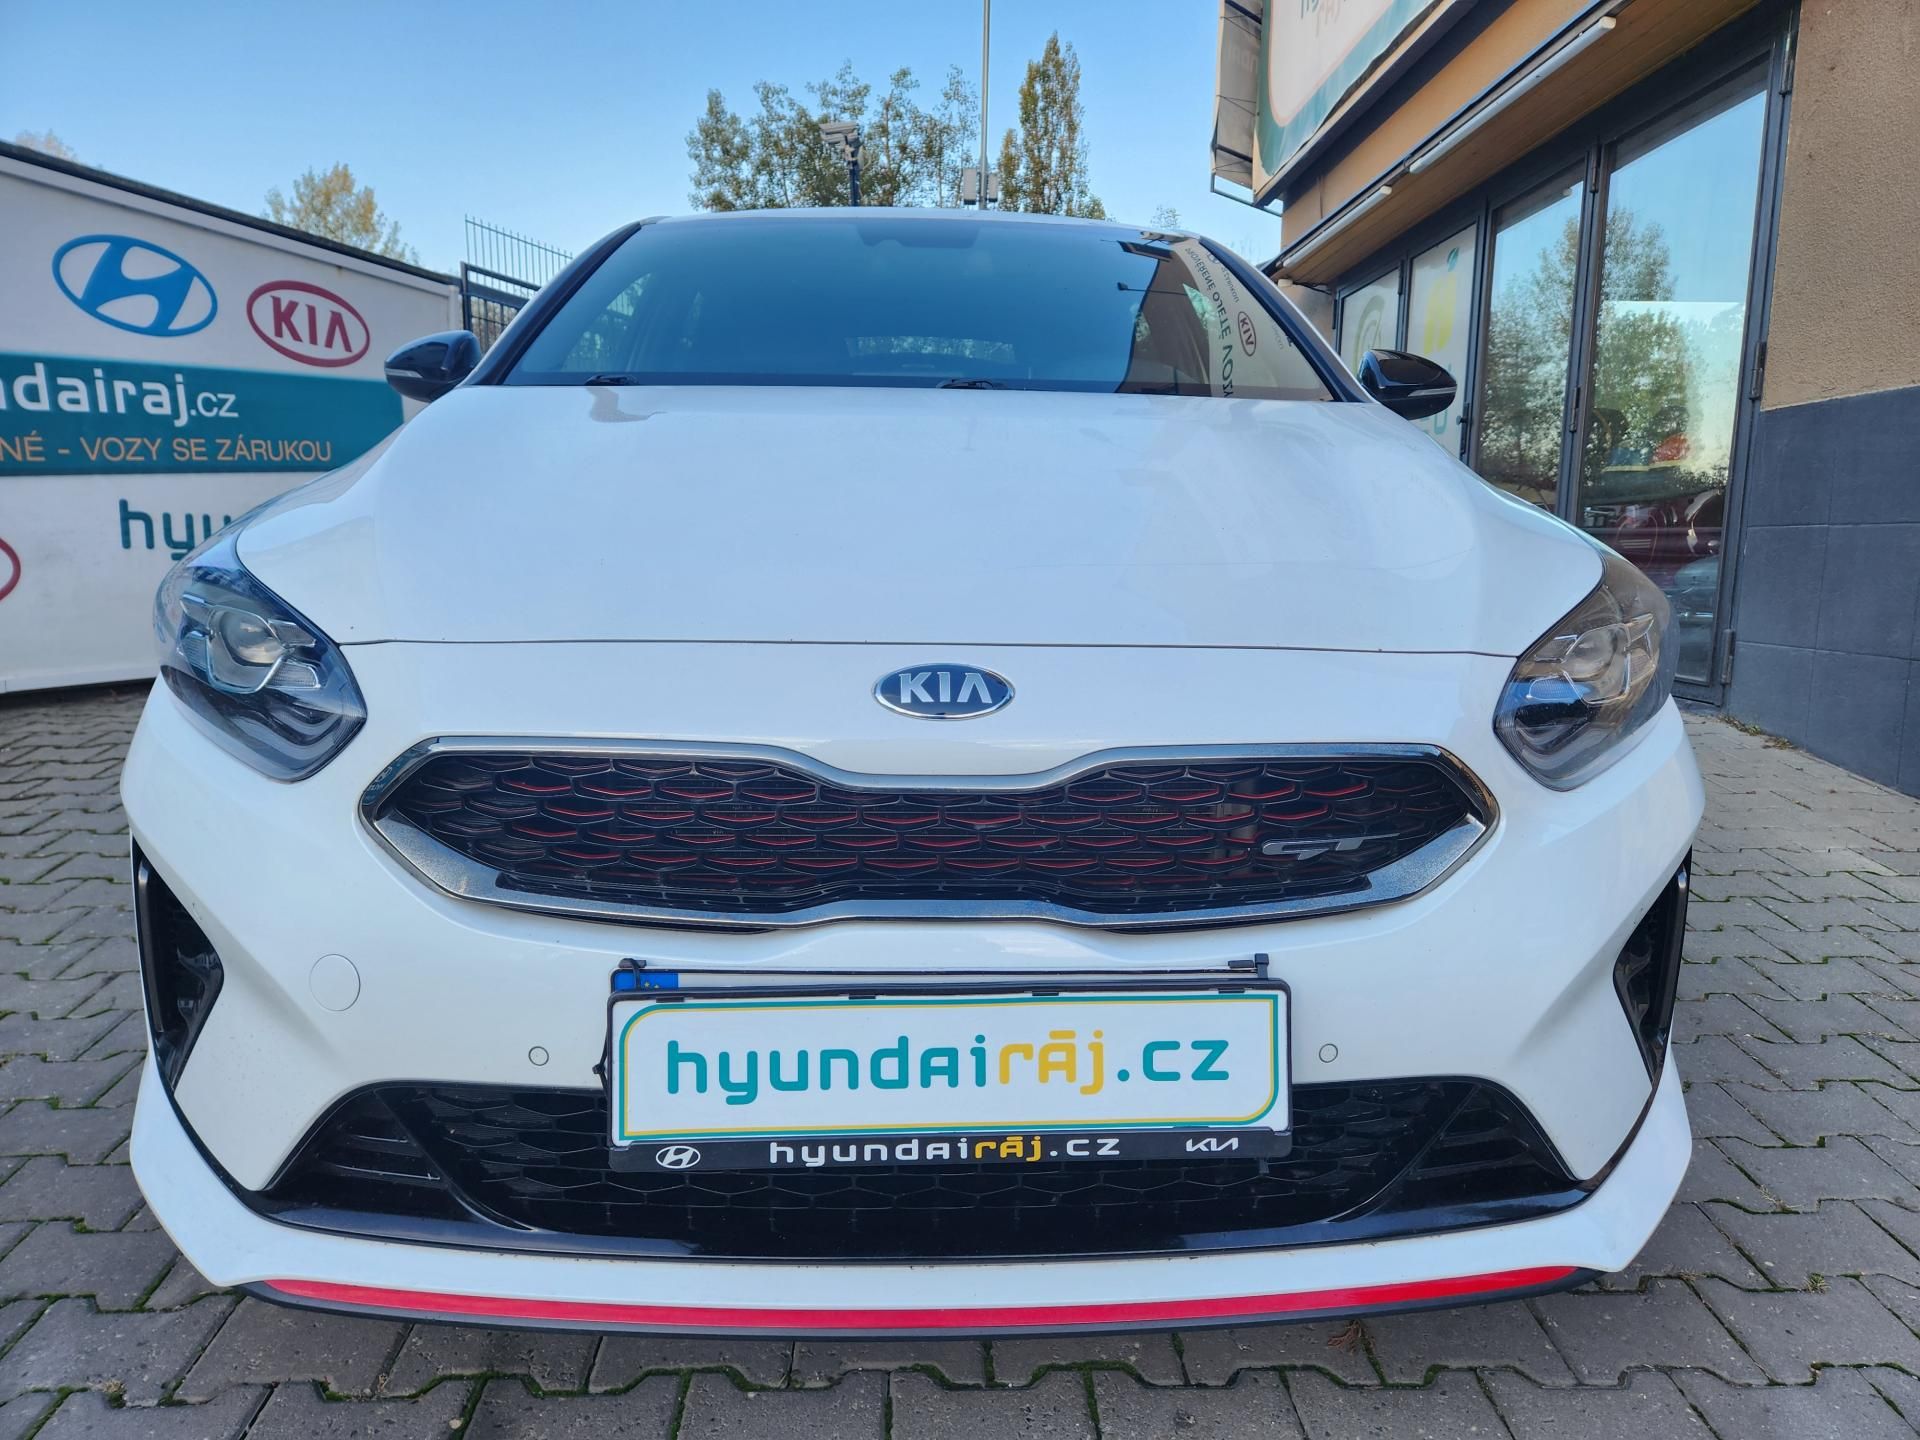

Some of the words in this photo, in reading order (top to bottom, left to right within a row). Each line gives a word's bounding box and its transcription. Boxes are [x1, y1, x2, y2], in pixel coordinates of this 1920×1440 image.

[270, 295, 353, 353] KIA
[80, 436, 162, 462] VOZY
[173, 438, 208, 461] SE
[216, 434, 331, 462] ZÁRUKOU
[899, 671, 993, 704] KIA
